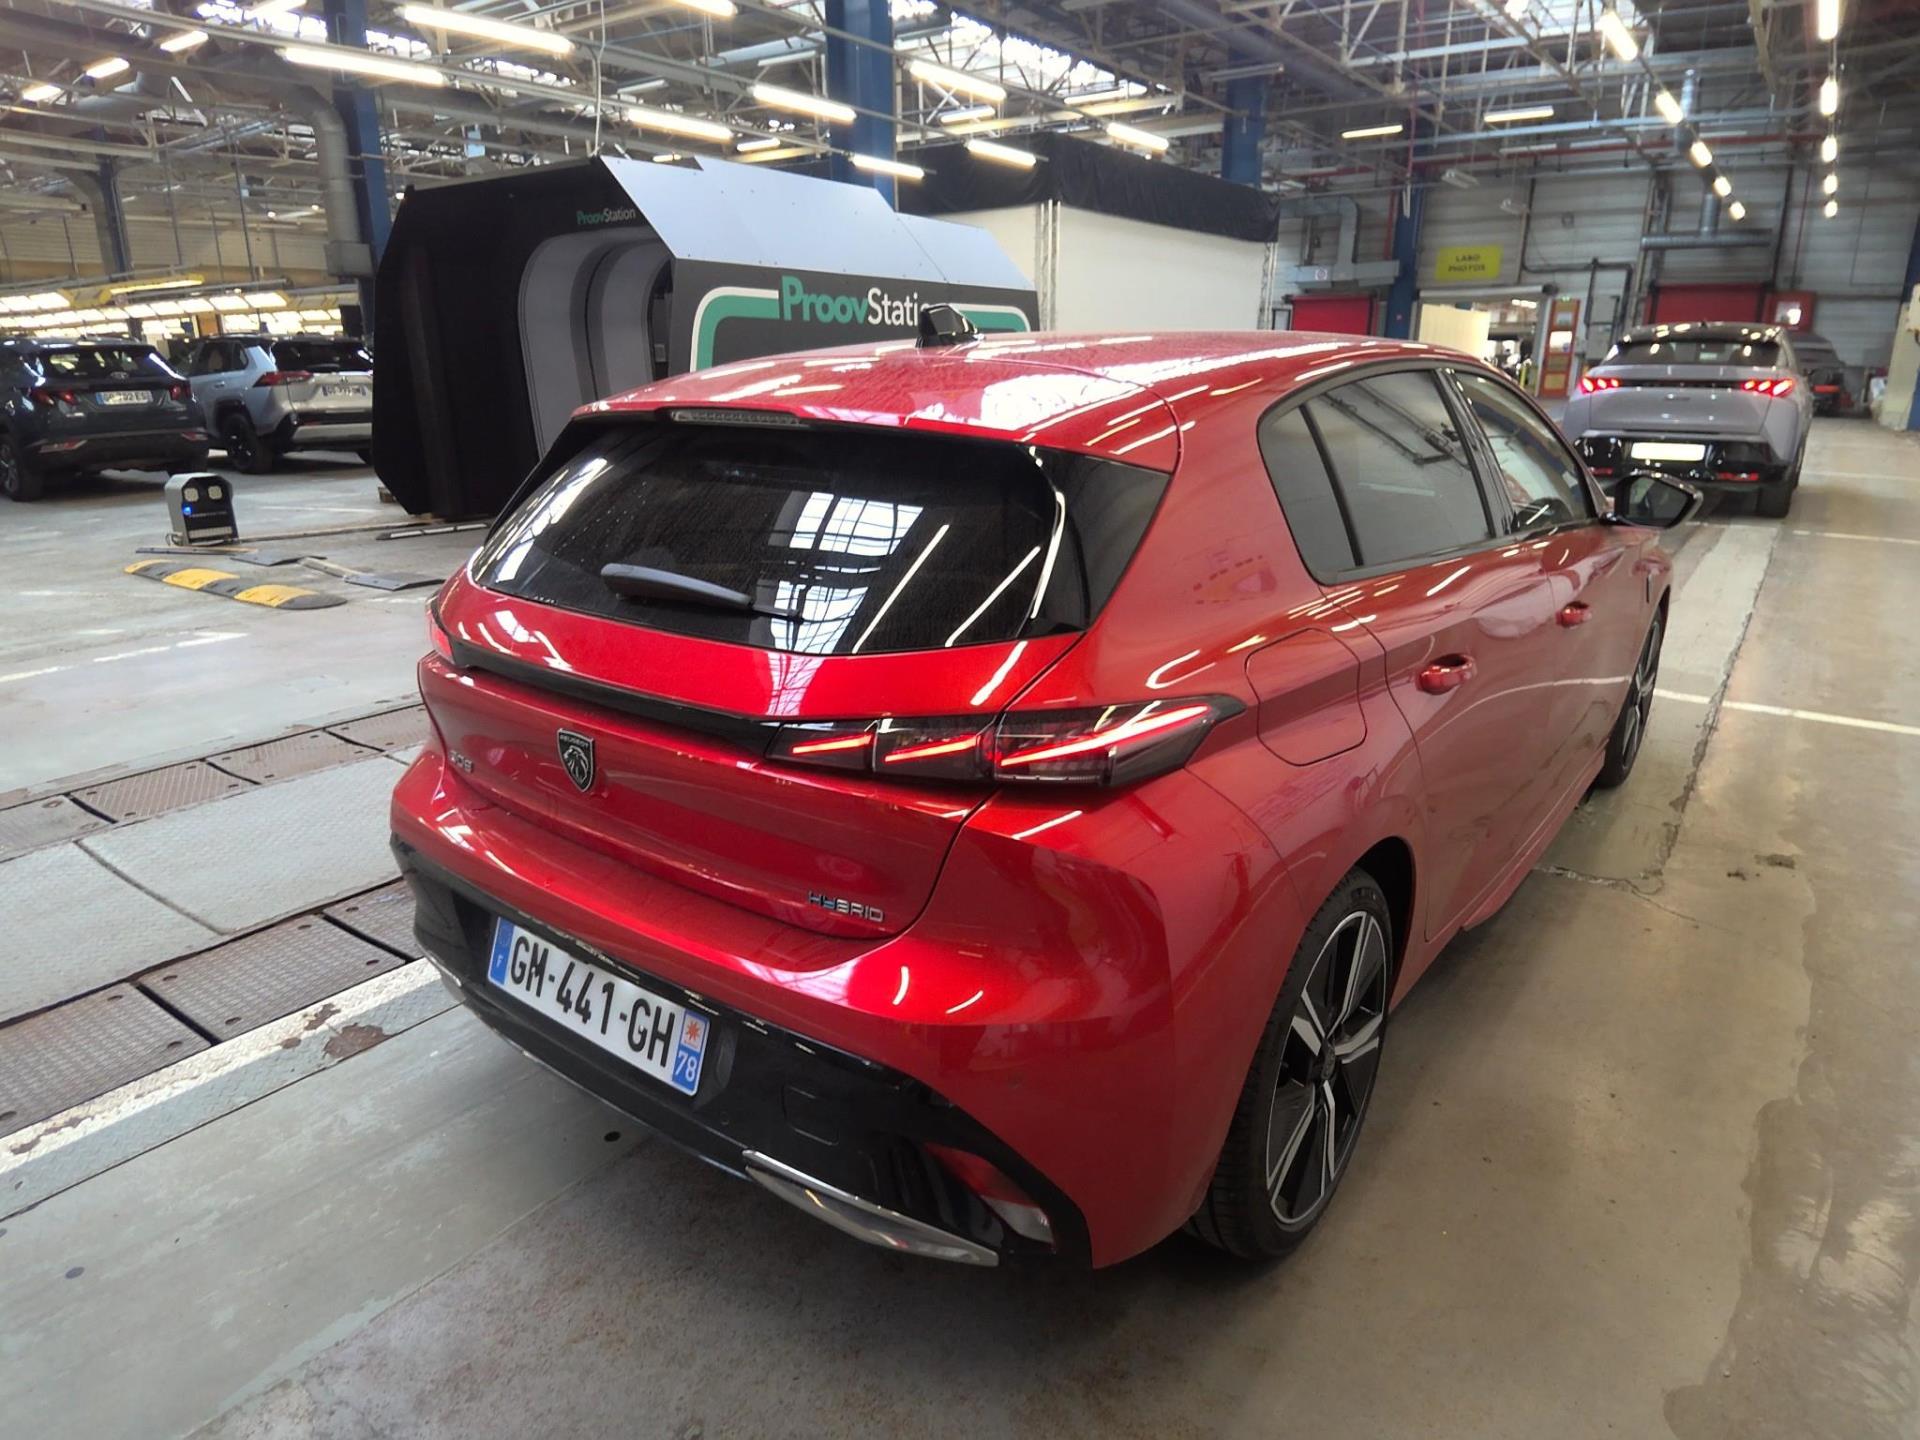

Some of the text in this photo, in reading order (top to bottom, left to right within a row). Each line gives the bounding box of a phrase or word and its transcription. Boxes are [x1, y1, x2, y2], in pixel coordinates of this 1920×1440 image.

[782, 275, 930, 326] ProovStati
[808, 890, 884, 922] HYBRID
[496, 955, 504, 968] F
[511, 936, 676, 1068] GM-441-GH
[675, 1051, 698, 1082] 78
